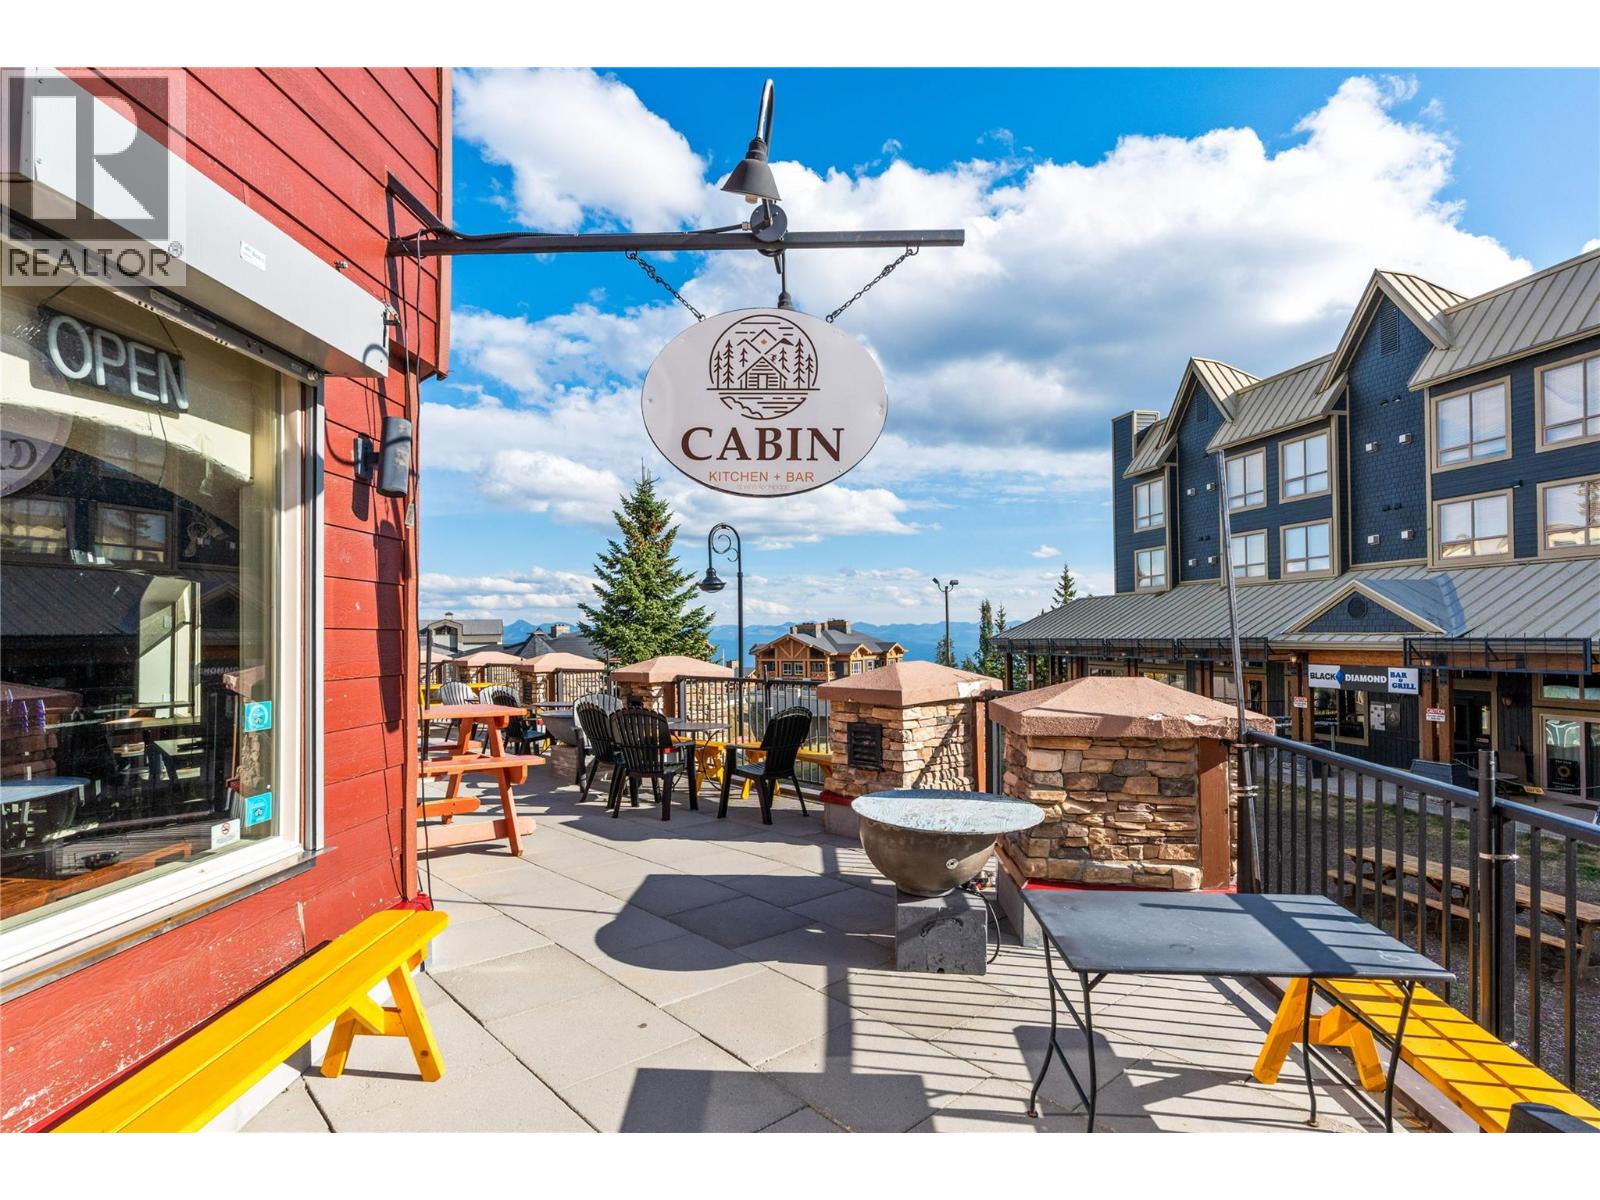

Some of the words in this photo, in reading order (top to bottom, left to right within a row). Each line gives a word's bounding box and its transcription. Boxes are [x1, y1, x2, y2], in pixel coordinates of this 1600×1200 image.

[48, 315, 189, 410] OPEN
[681, 427, 845, 462] CABIN
[708, 471, 769, 482] KITCHEN
[774, 473, 781, 481] +
[786, 471, 815, 482] BAR
[1309, 672, 1336, 680] BLACK
[1344, 674, 1387, 683] DIAMOND
[1390, 671, 1408, 679] BAR
